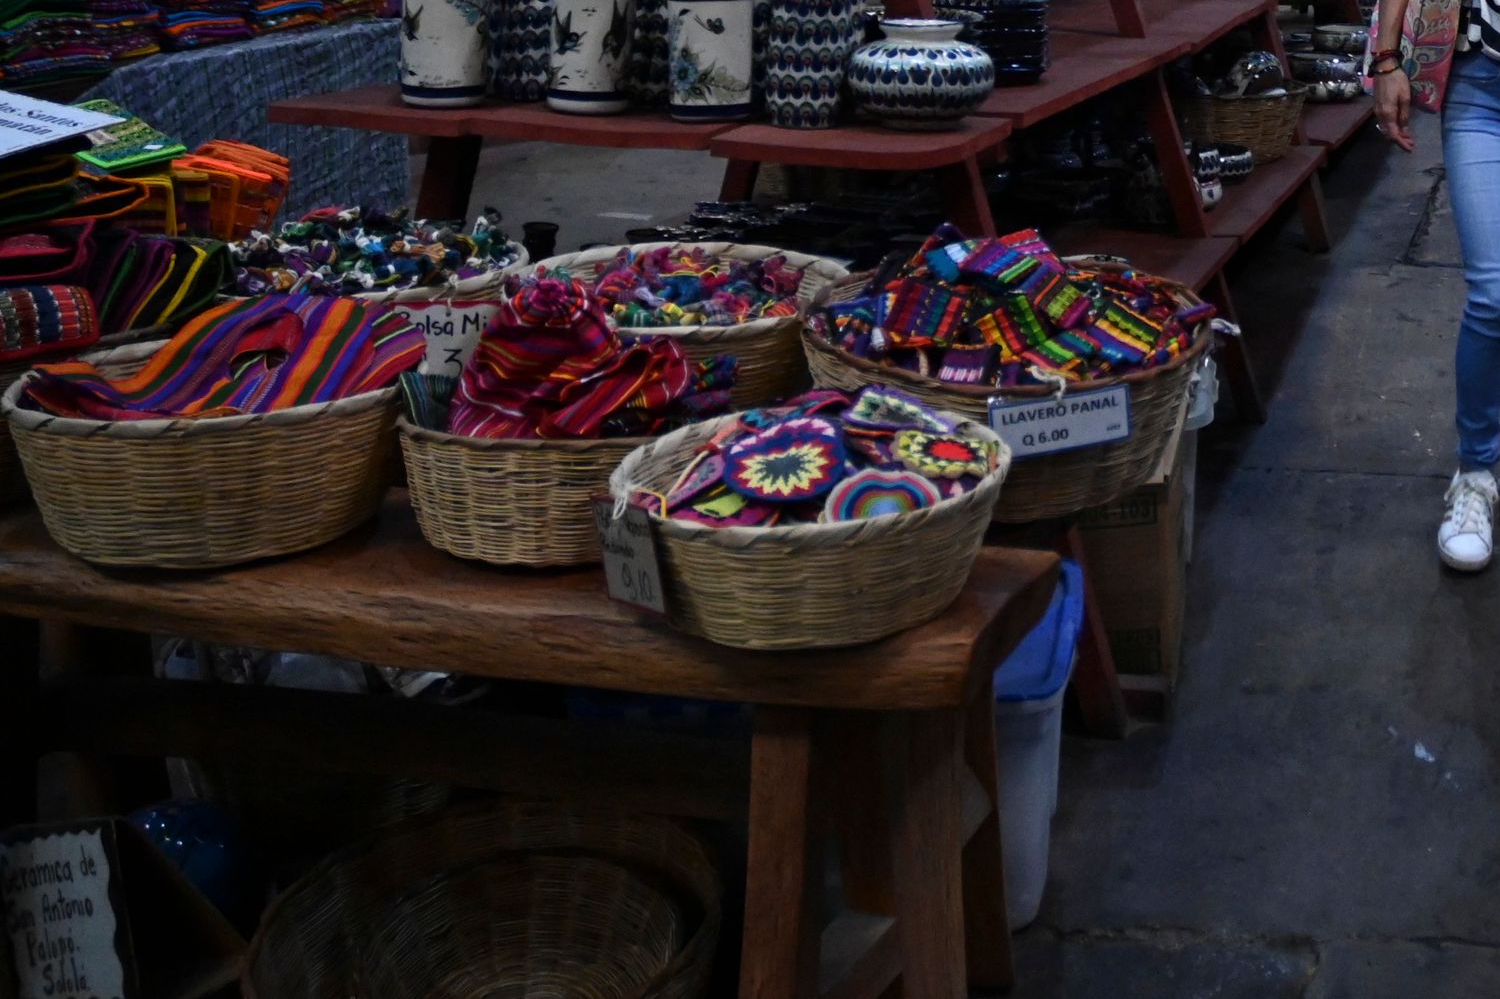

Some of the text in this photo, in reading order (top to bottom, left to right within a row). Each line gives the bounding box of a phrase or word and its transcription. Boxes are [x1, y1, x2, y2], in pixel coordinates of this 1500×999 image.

[17, 109, 83, 127] Santos
[1001, 395, 1118, 425] LLAVERO PANAL
[1022, 428, 1069, 447] Q 6.00
[42, 888, 94, 923] Antonio
